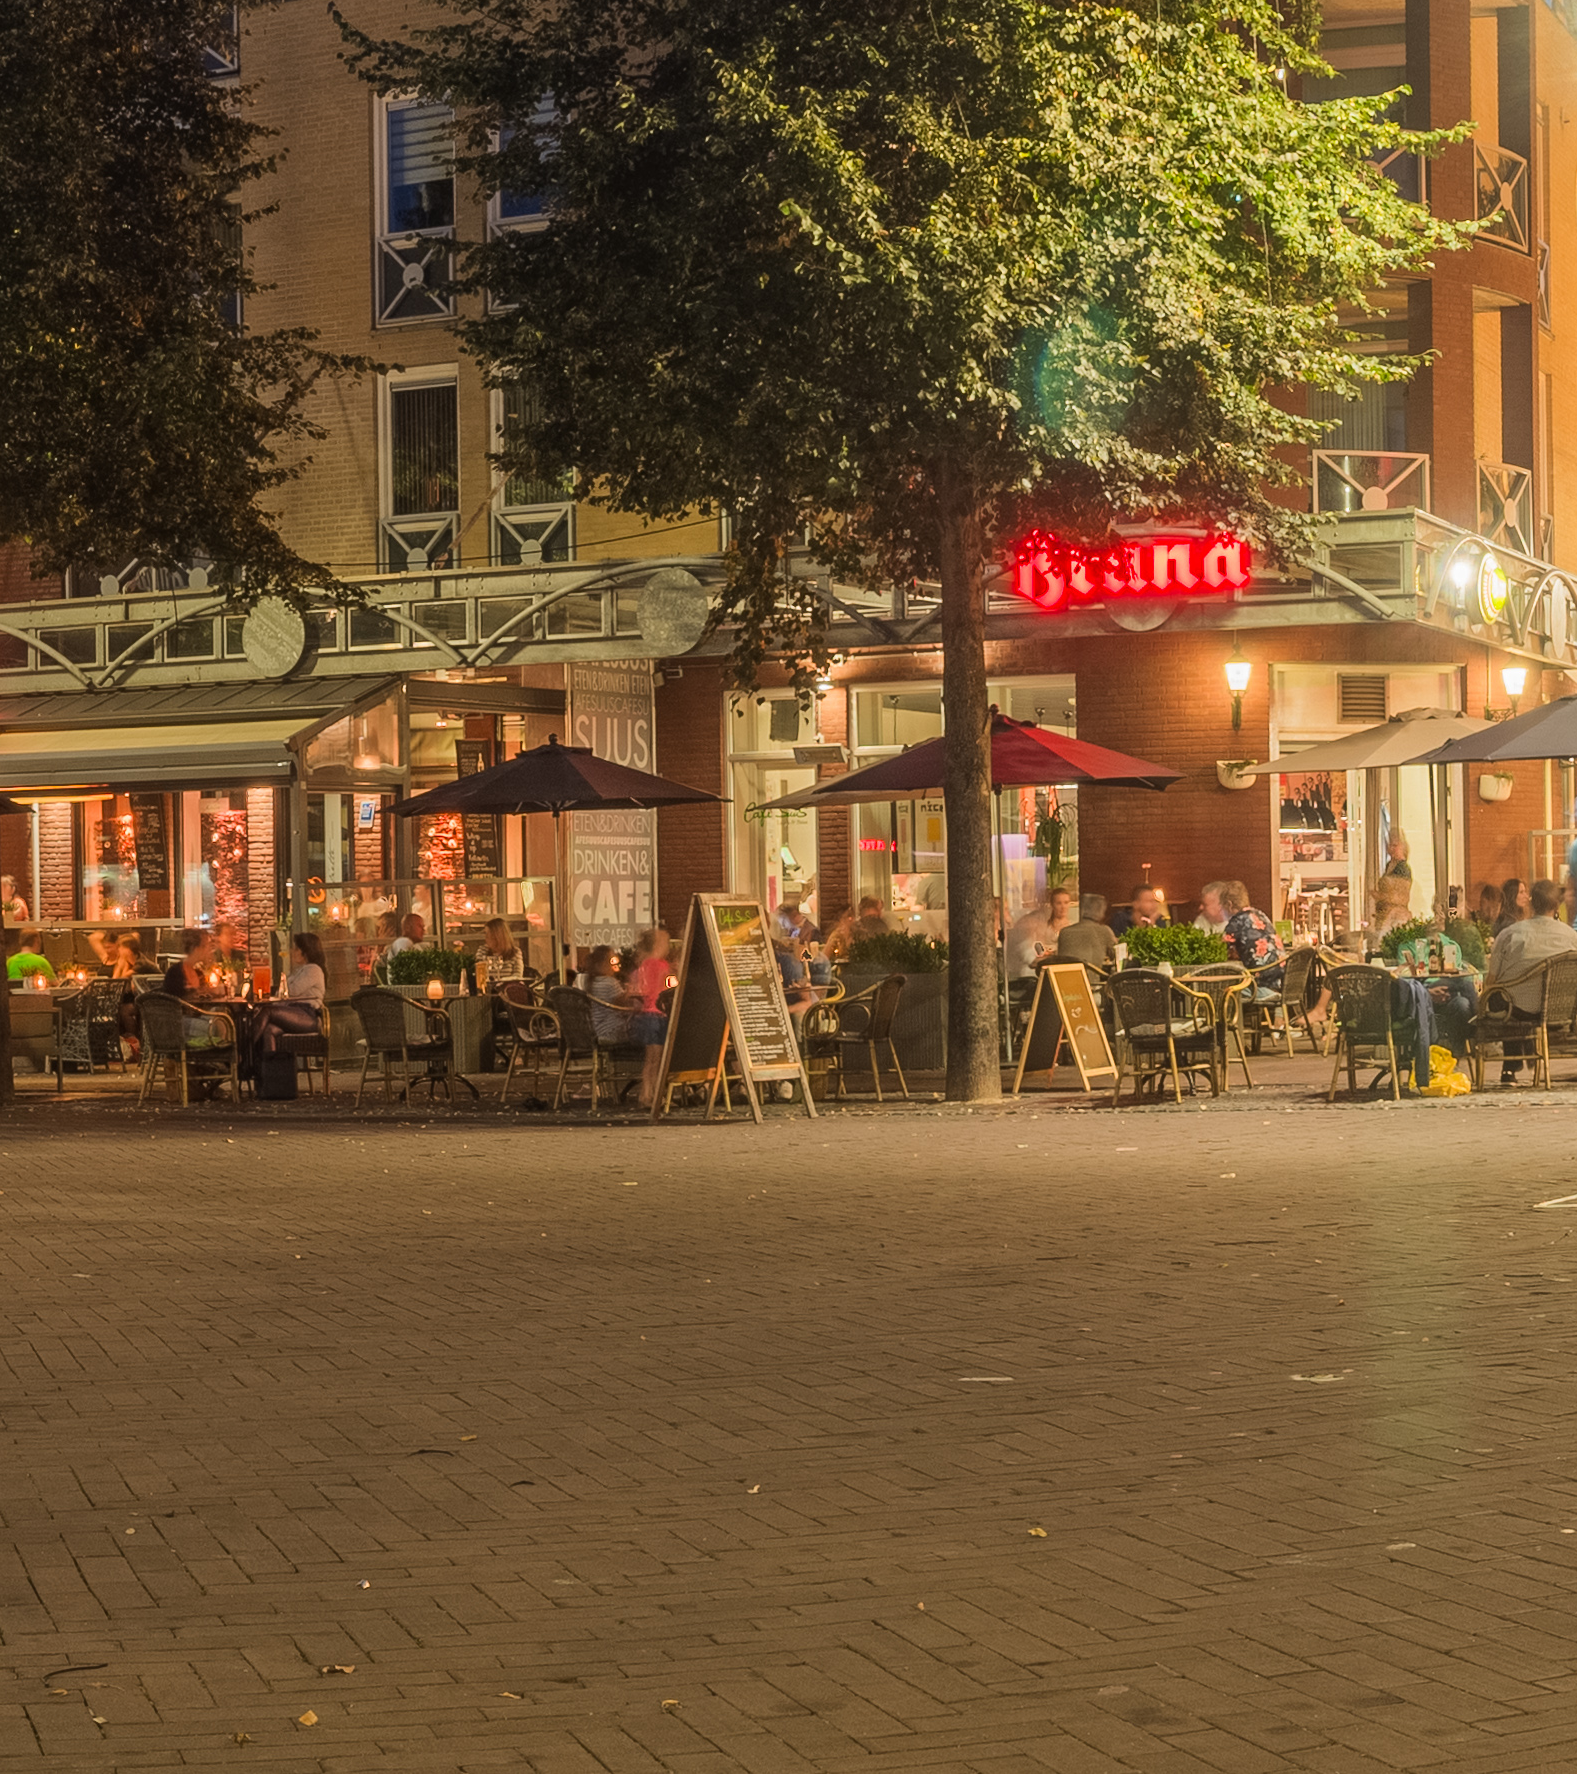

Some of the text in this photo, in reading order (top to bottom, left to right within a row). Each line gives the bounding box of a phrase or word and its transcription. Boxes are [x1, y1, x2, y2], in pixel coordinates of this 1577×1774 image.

[575, 714, 649, 769] SUUS
[574, 813, 651, 834] ETEN&DRINKEN
[574, 849, 651, 875] DRINKEN&
[573, 879, 651, 925] CAFE
